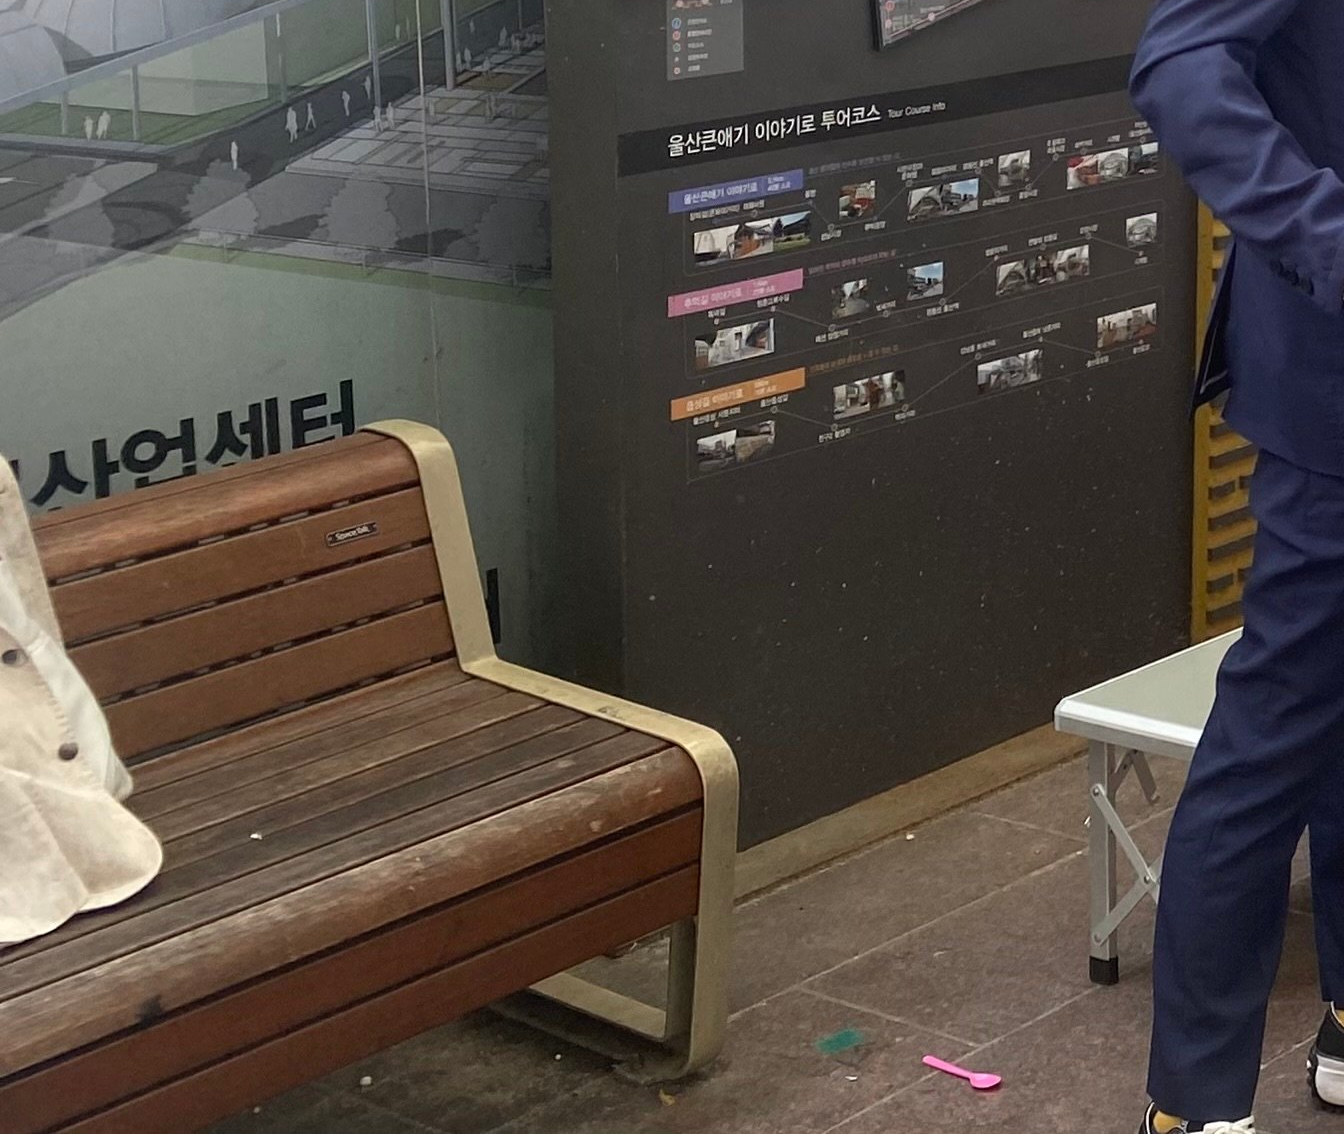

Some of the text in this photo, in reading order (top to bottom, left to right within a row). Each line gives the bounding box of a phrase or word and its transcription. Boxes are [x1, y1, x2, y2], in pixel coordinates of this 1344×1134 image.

[667, 101, 946, 157] 울산큰애기 이야기로 투어코스 Tour Course Info
[9, 379, 356, 511] 사업센터
